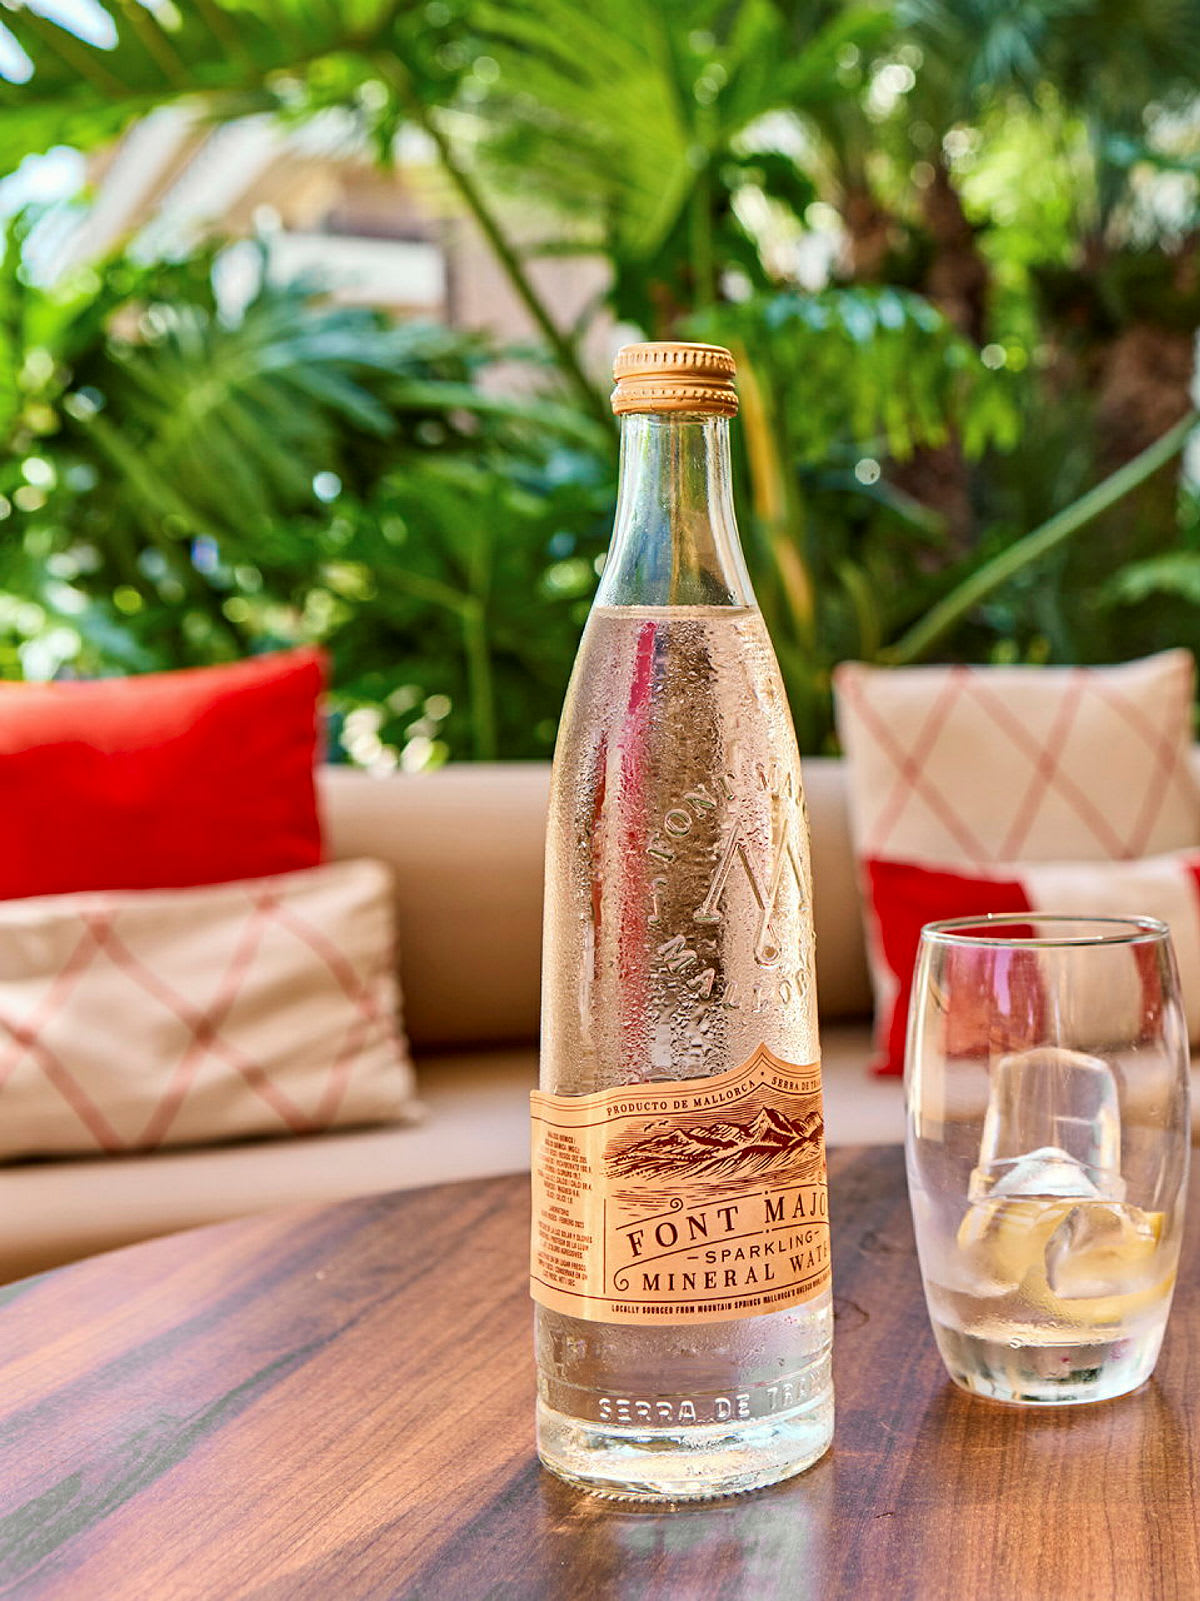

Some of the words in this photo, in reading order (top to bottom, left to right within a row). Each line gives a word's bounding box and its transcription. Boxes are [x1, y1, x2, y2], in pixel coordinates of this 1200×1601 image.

[606, 1101, 667, 1117] PRODUCTO
[673, 1099, 689, 1111] DE
[693, 1079, 756, 1107] MALLORCA
[771, 1076, 799, 1091] SERRA
[801, 1081, 810, 1091] DE
[626, 1205, 739, 1258] FONT
[642, 1263, 776, 1292] MINERAL
[611, 1304, 640, 1314] LOCALLY
[642, 1306, 673, 1315] SOURCED
[675, 1305, 695, 1314] FROM
[697, 1302, 732, 1314] MOUNTAIN
[734, 1297, 761, 1309] SPRINGS
[598, 1397, 697, 1422] SERRA
[714, 1393, 751, 1419] DE
